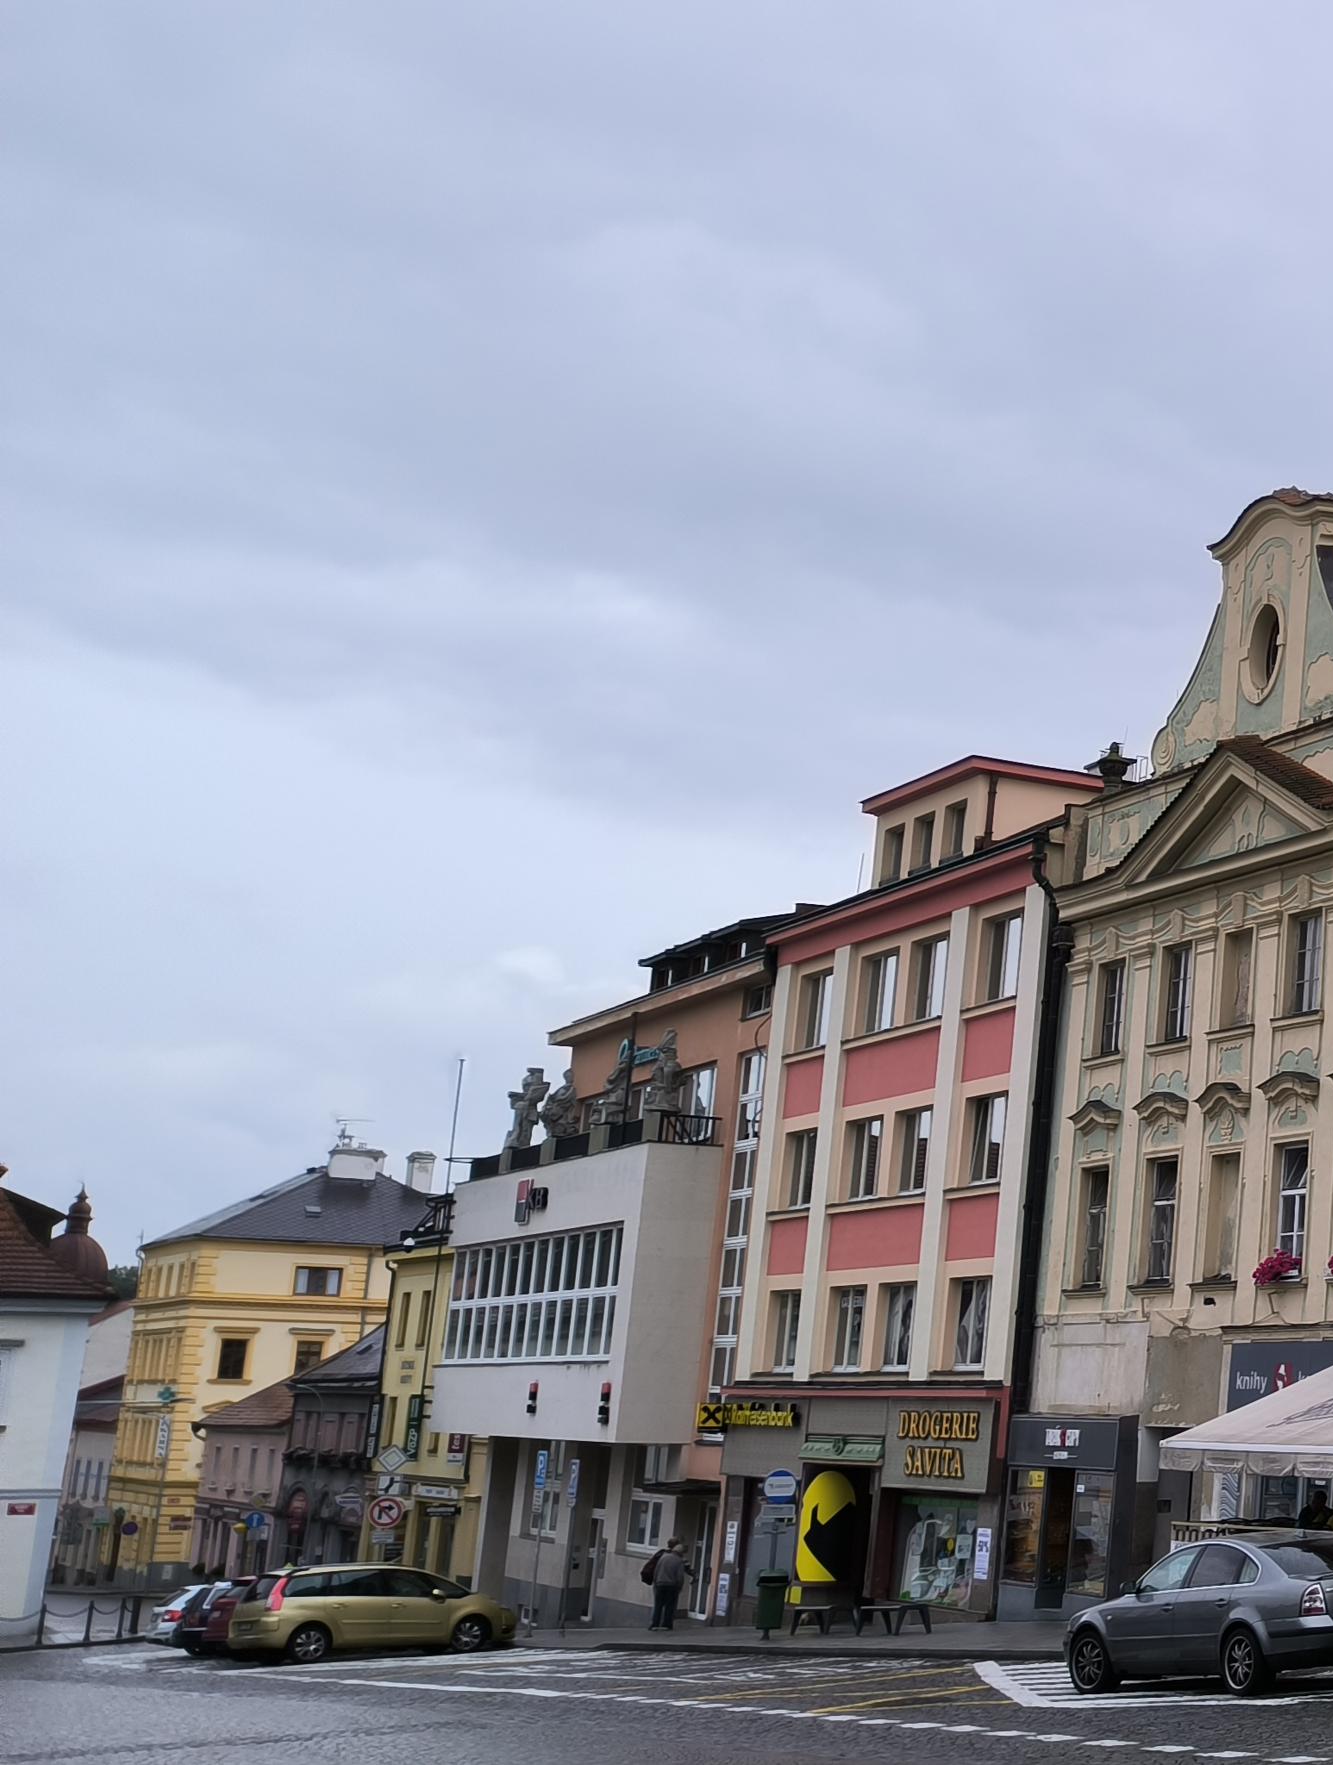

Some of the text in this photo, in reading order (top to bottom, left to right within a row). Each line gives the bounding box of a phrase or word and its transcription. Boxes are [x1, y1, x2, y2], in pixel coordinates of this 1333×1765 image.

[1235, 1371, 1268, 1394] knihy
[897, 1410, 981, 1440] DROGERIE
[904, 1446, 965, 1479] SAVITA
